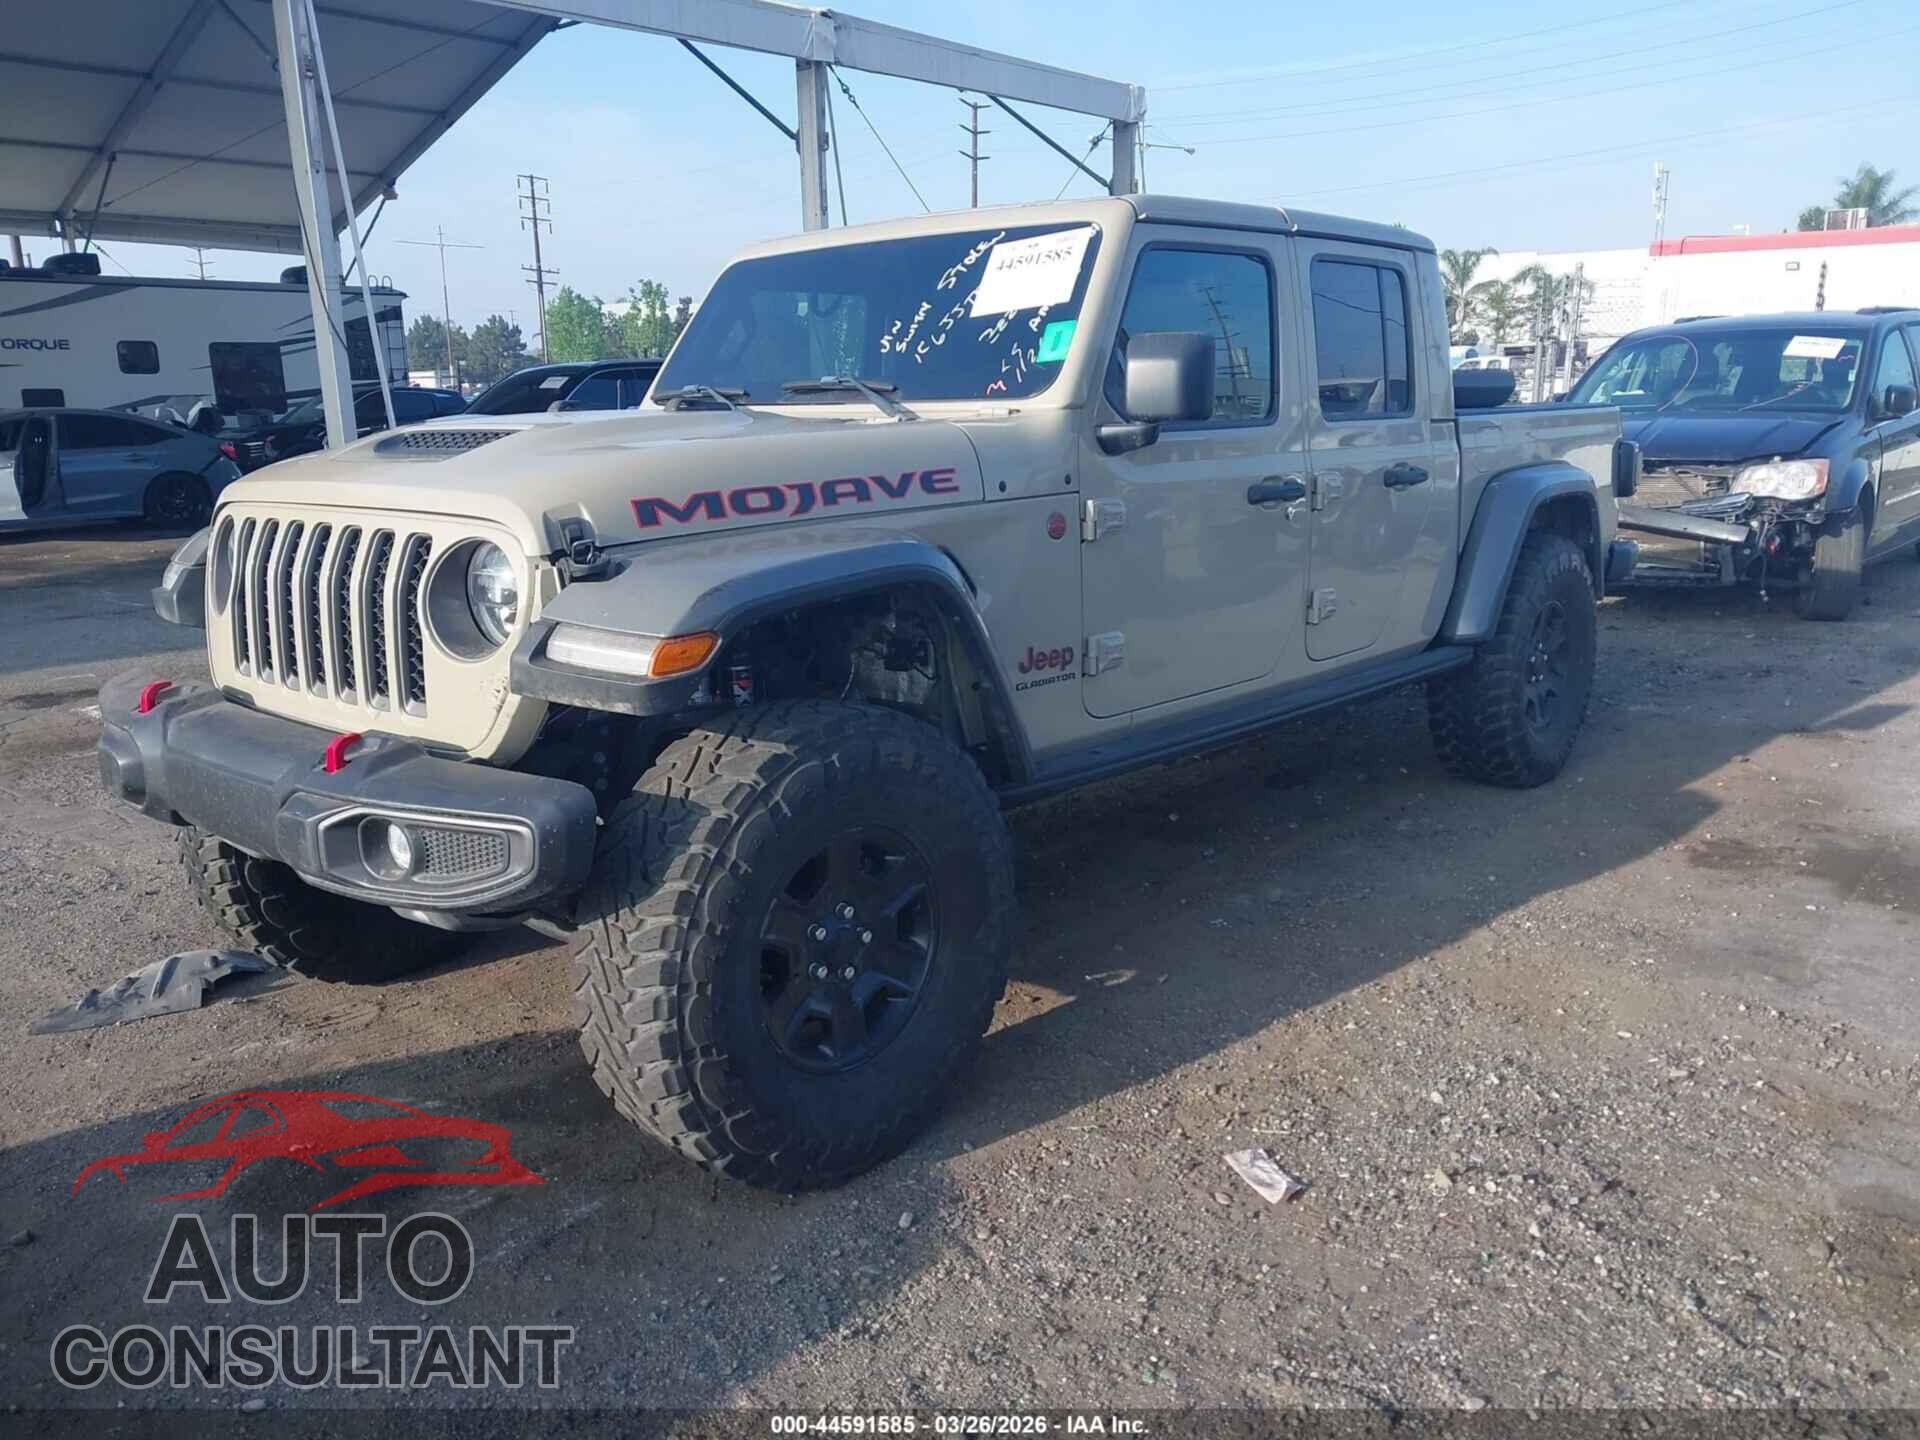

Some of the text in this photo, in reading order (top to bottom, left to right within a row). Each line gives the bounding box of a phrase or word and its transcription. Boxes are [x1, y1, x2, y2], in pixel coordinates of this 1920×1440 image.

[996, 246, 1074, 271] 44591585
[0, 338, 71, 350] ORQUE
[631, 467, 960, 528] MOJAVE
[1018, 646, 1074, 674] Jeep
[1015, 671, 1076, 692] GLADIATOR
